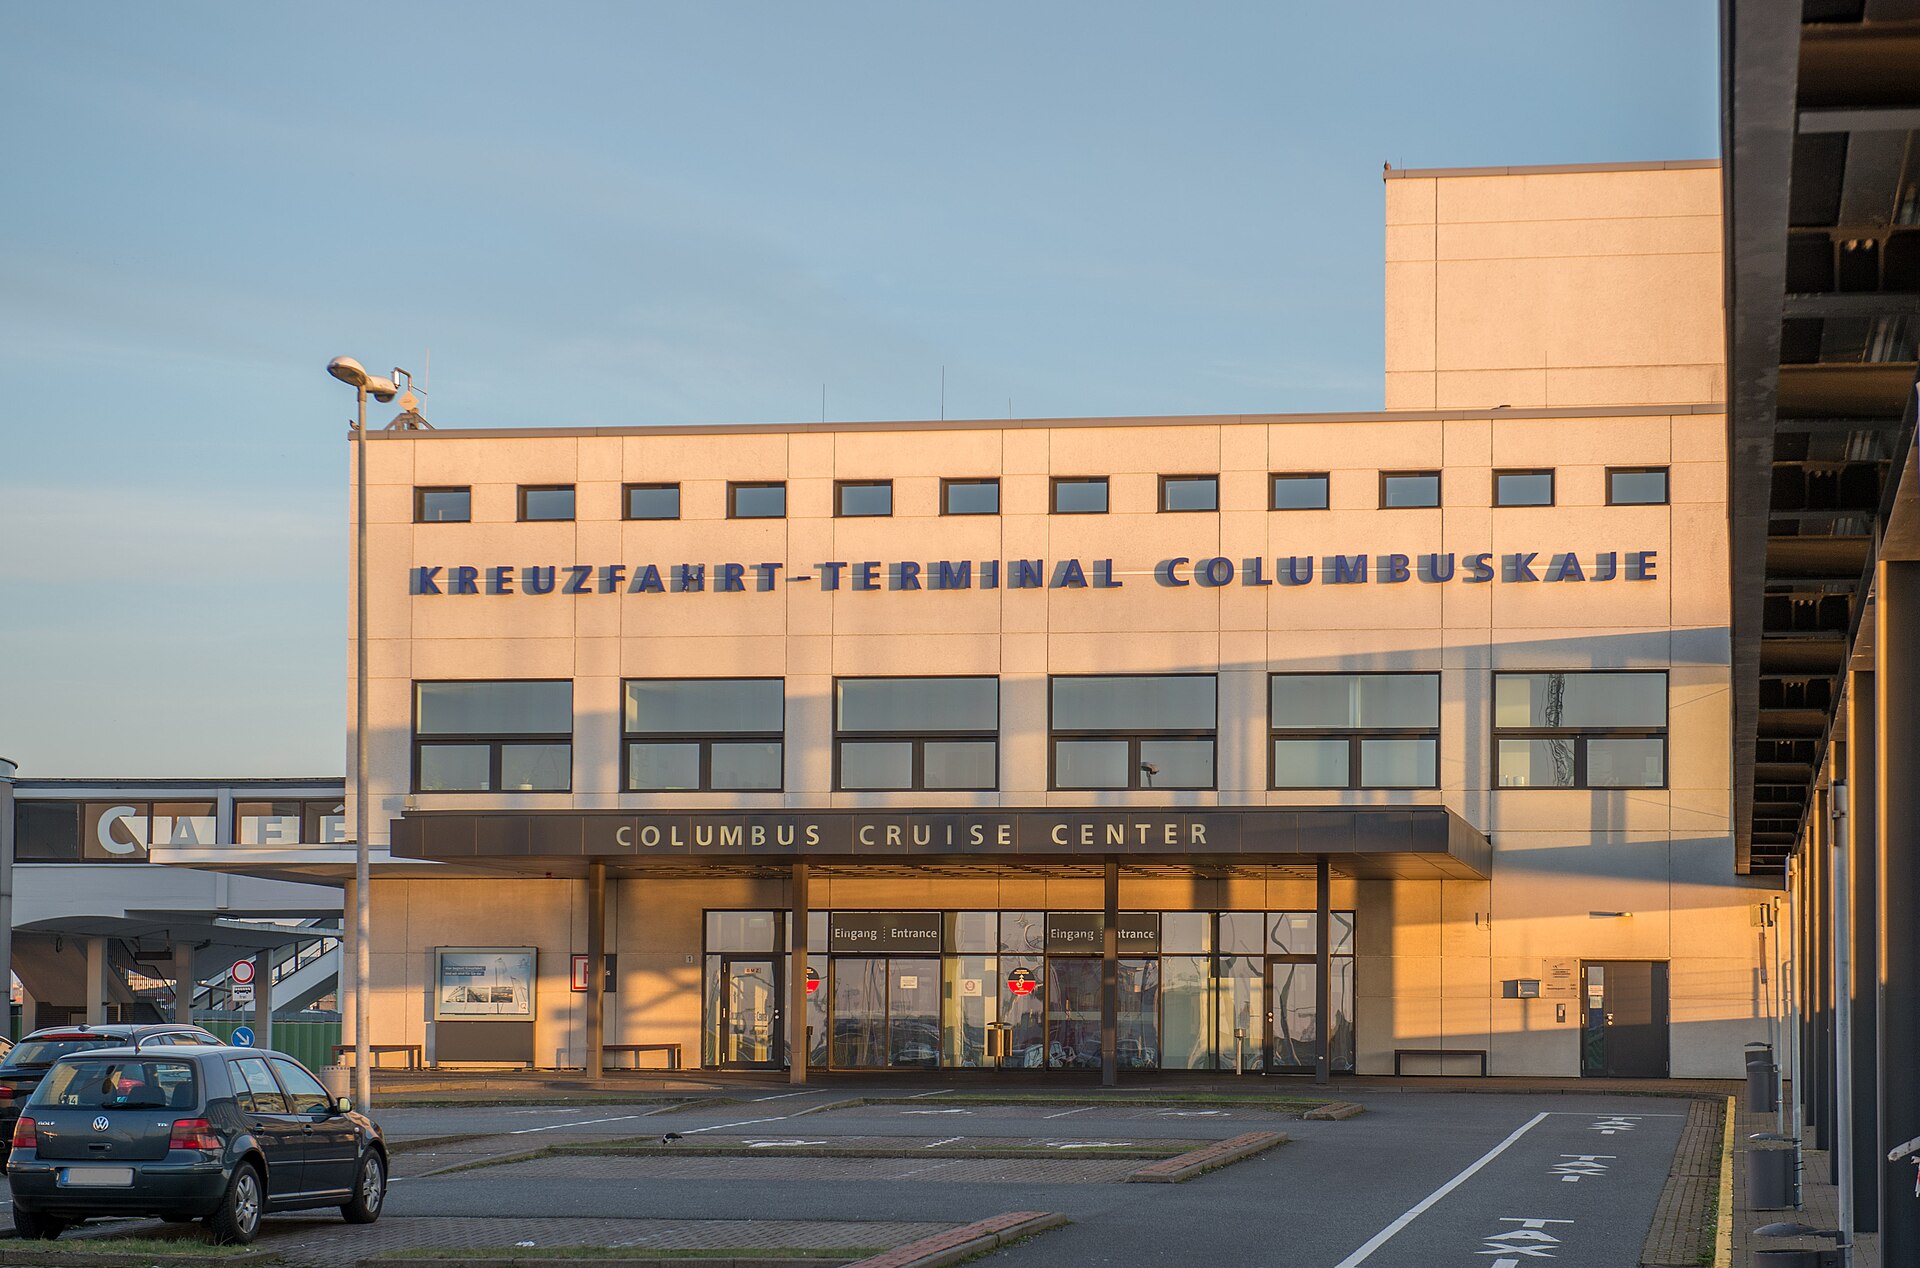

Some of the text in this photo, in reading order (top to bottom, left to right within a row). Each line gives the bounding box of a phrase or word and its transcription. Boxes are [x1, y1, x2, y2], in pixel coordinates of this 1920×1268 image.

[1166, 551, 1657, 586] COLUMBUSKAJE
[615, 823, 1207, 847] COLUMBUS CRUISE CENTER
[834, 928, 938, 940] Eingang Entrance
[1050, 928, 1094, 941] Eingang
